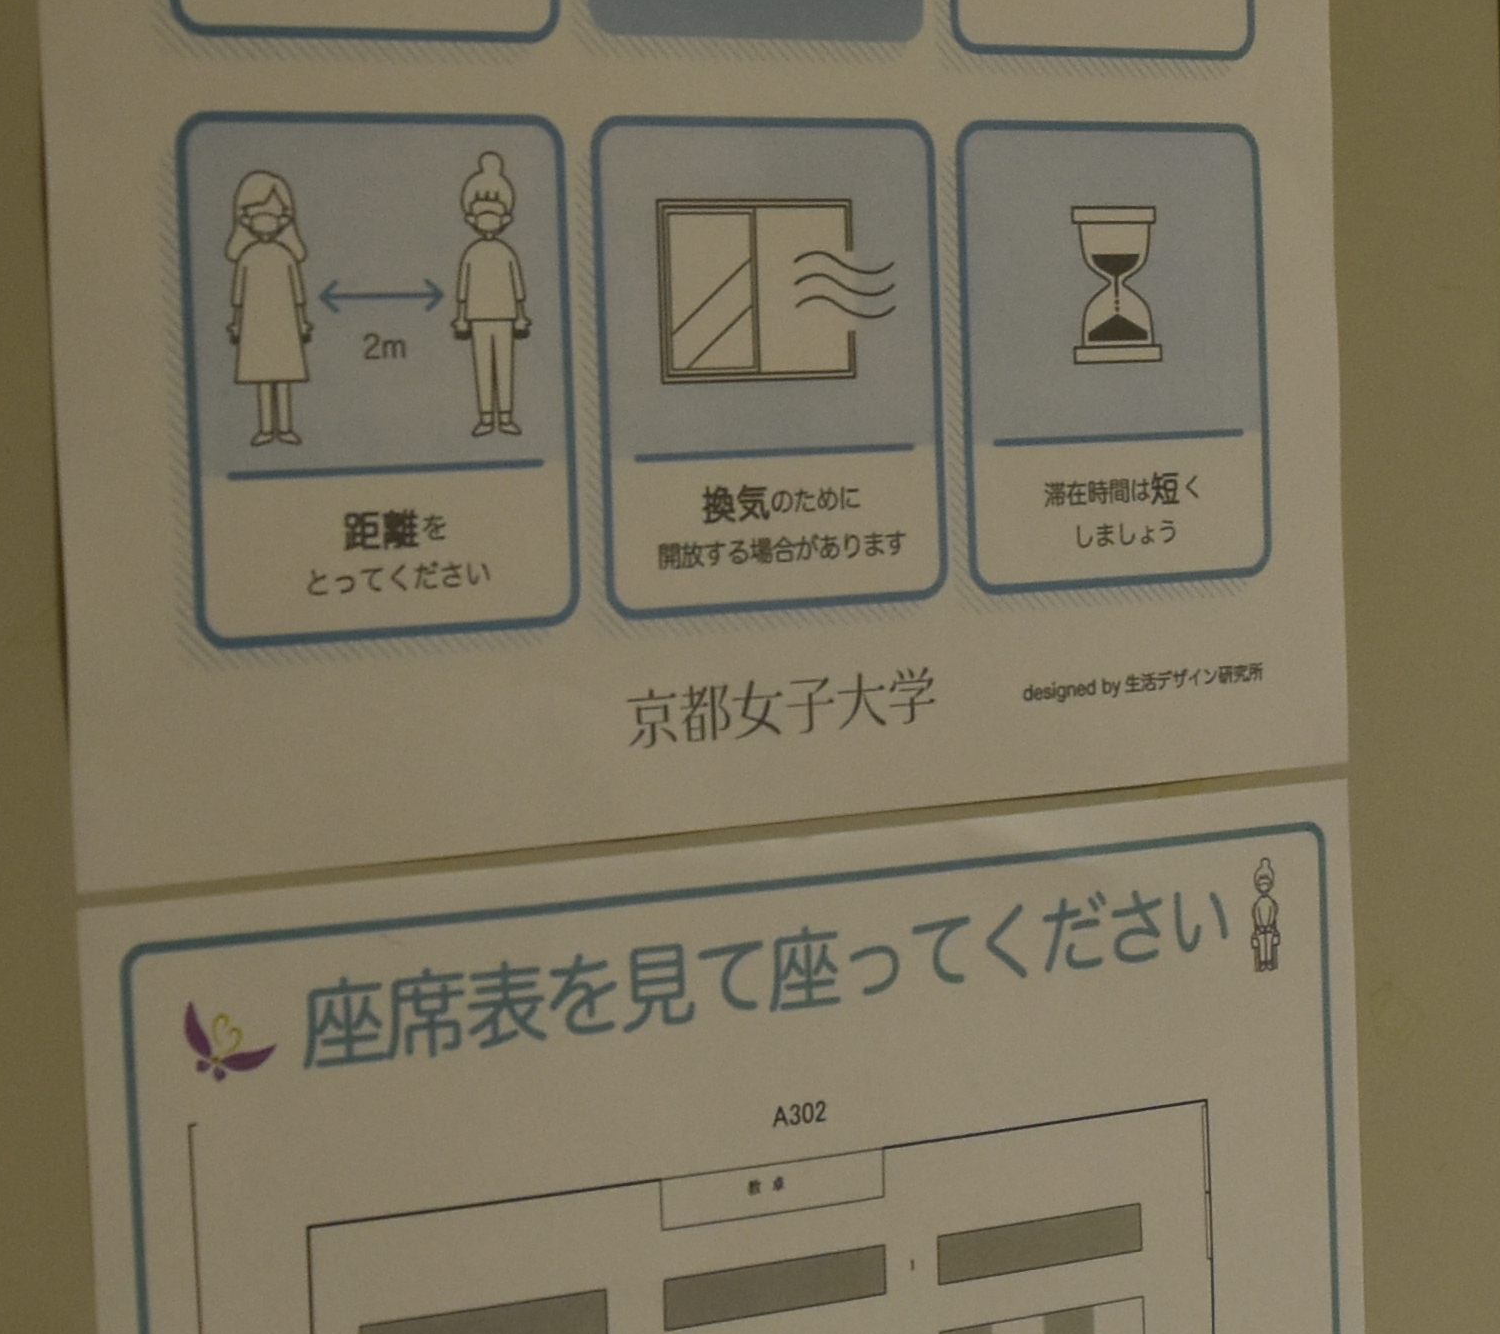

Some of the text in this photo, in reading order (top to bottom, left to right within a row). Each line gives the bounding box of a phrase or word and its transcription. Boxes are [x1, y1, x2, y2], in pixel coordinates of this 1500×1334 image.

[362, 331, 408, 361] 2m
[701, 484, 861, 525] 換気のために
[1044, 471, 1202, 508] 滞在時間は短く
[343, 509, 446, 552] 距離を
[657, 530, 907, 571] 開放する場合があります
[1075, 519, 1177, 550] しましょう
[306, 560, 491, 597] とってください
[1022, 661, 1264, 704] designed by 生活デザイン研究所
[626, 666, 936, 749] 京都女子大学
[302, 889, 1229, 1070] 座席表を見て座ってください
[771, 1099, 827, 1128] A302
